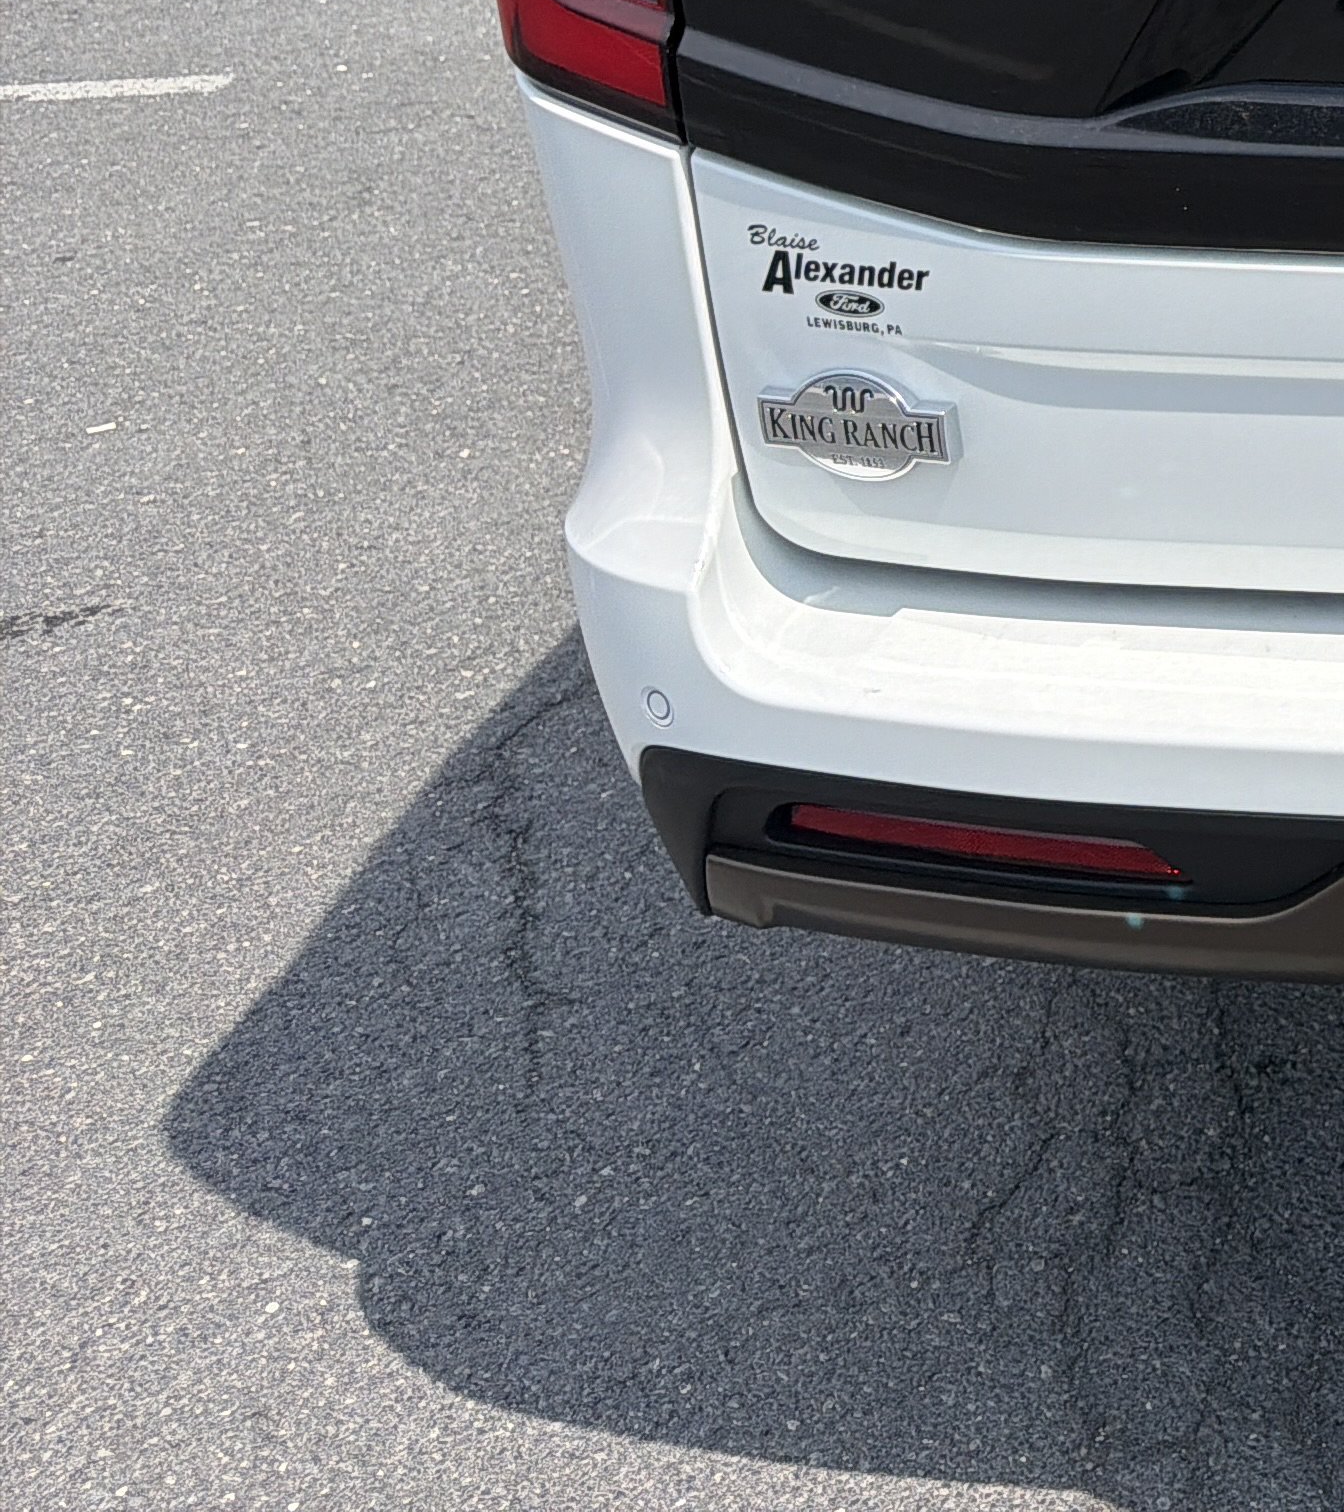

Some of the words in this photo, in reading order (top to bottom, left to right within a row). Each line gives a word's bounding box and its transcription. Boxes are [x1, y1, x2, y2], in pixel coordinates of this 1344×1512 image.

[747, 224, 820, 251] Blaise
[762, 249, 930, 295] Alexander
[829, 292, 871, 314] Ford
[806, 316, 885, 336] LEWISBURG,
[887, 323, 903, 336] PA
[769, 407, 837, 444] KING
[841, 419, 937, 453] RANCH
